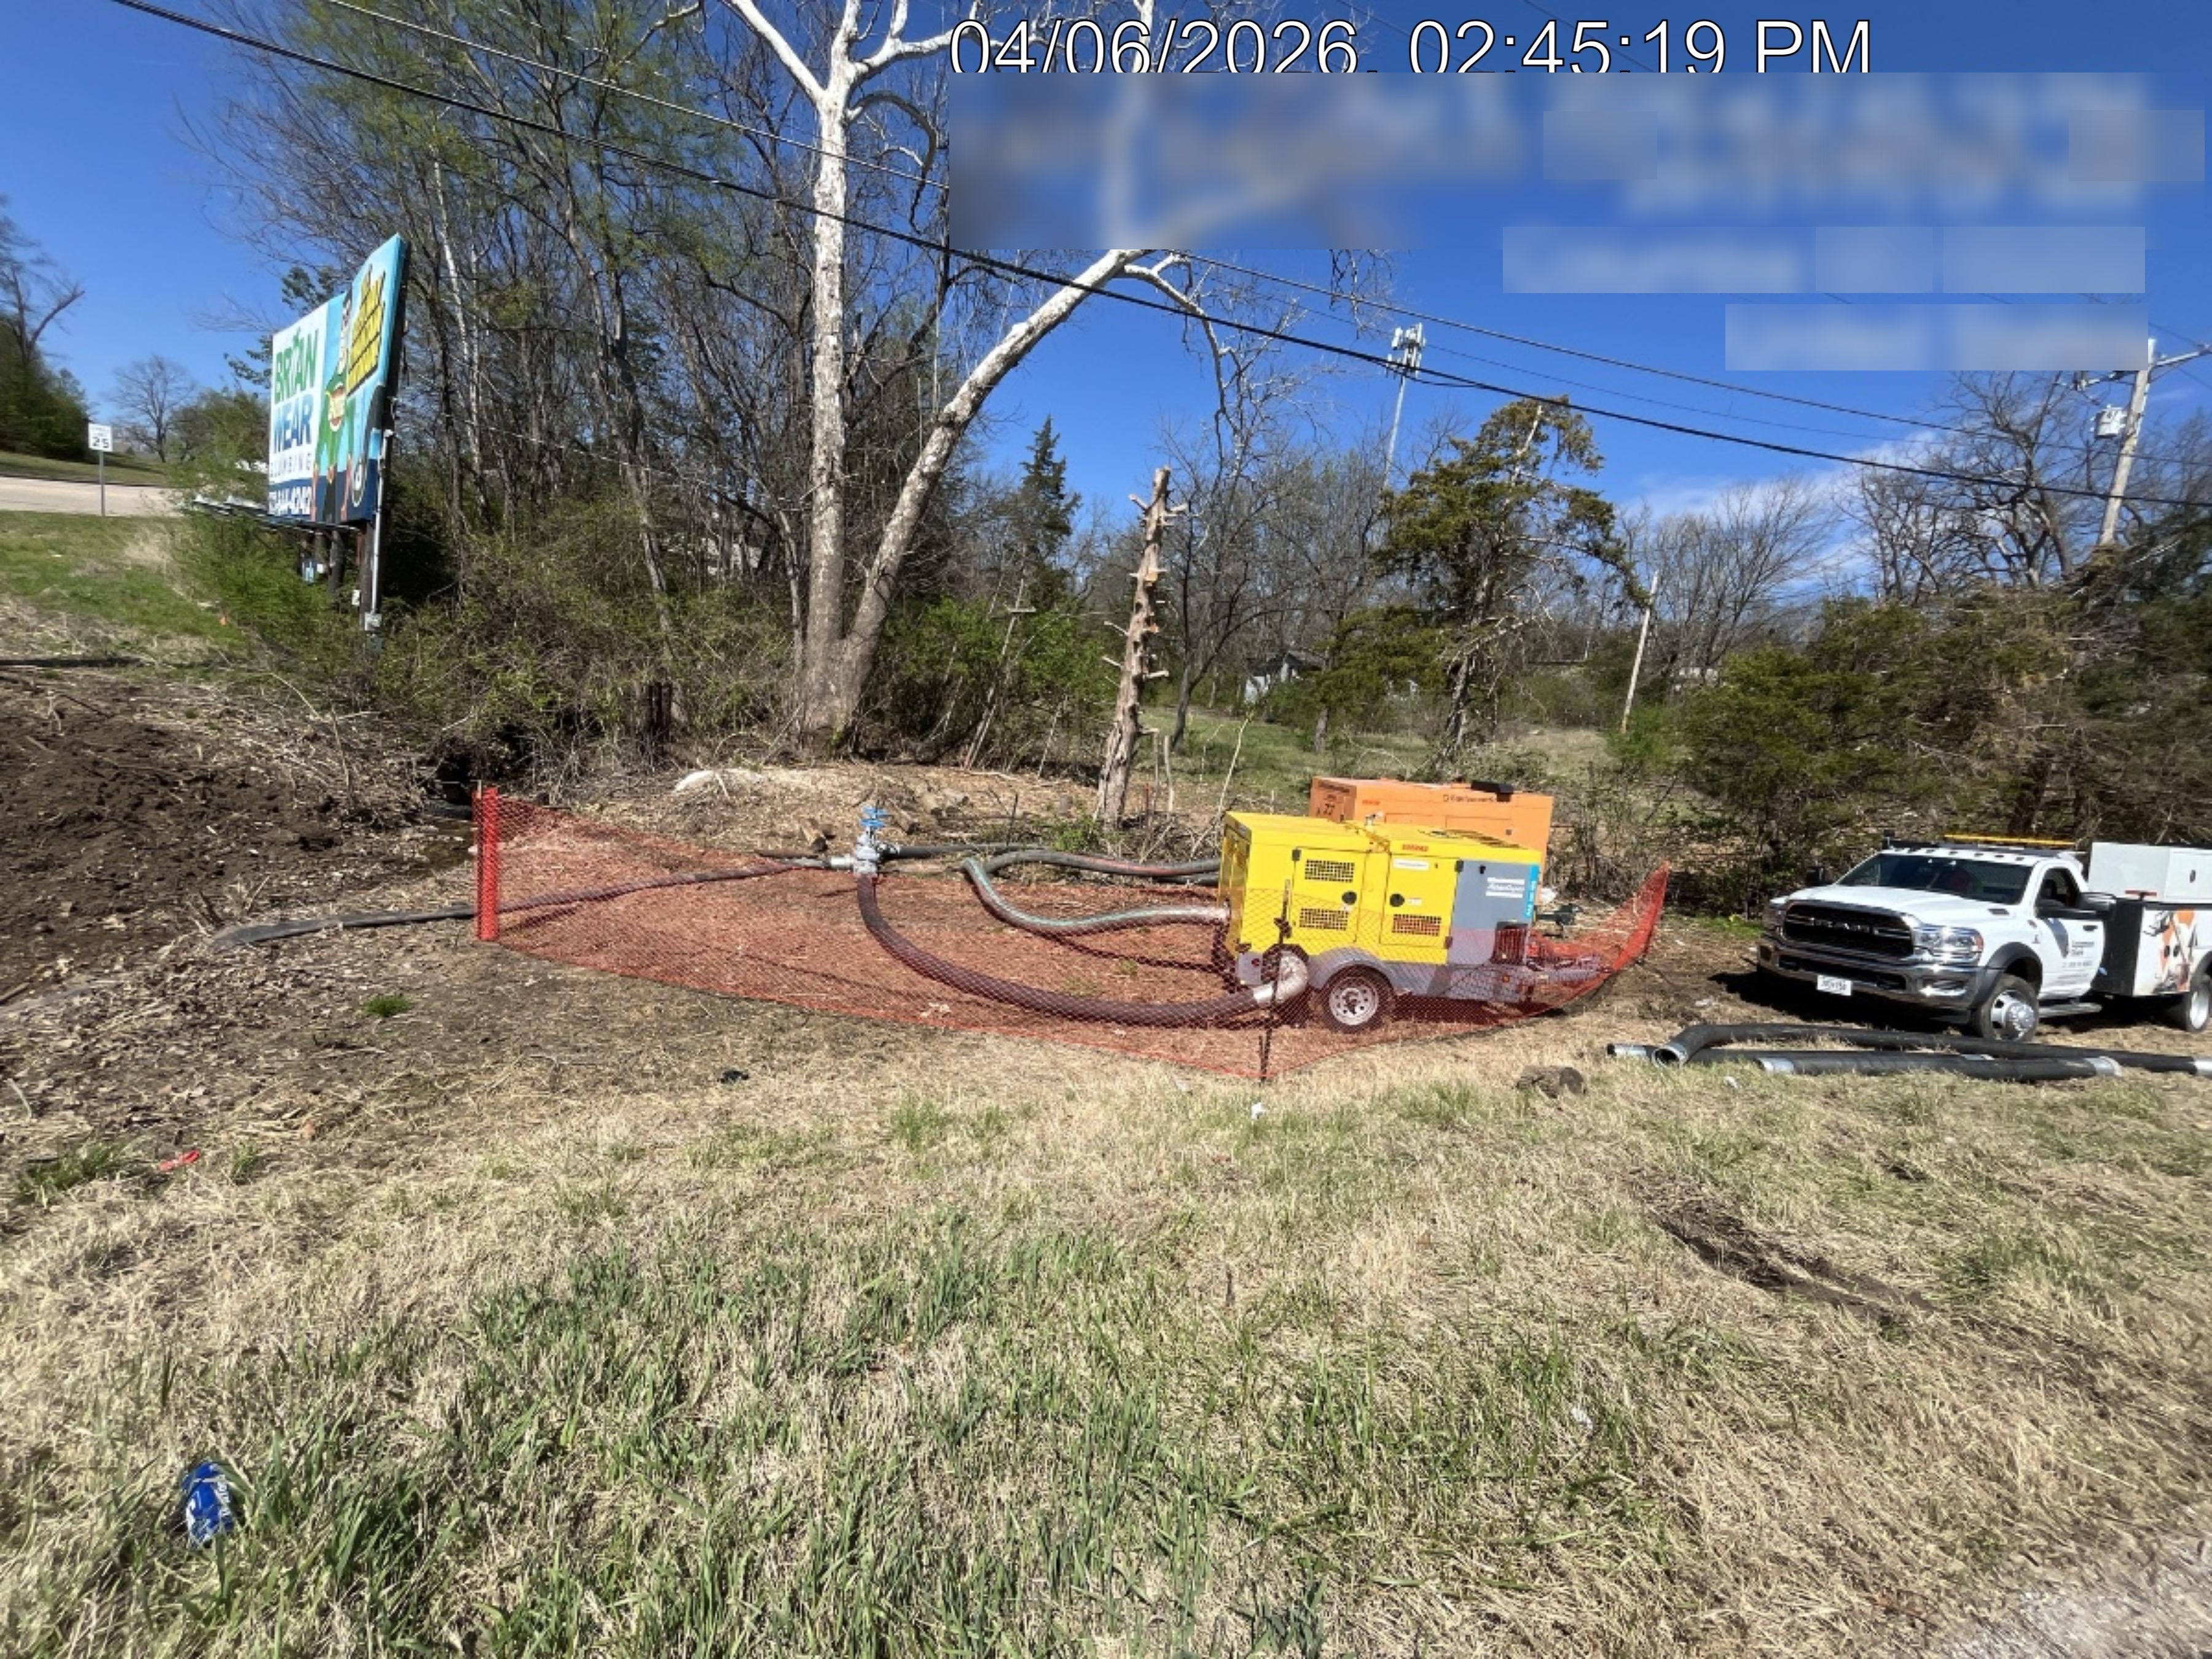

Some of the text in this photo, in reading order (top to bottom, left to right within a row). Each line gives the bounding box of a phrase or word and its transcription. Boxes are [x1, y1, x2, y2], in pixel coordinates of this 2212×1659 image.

[275, 328, 319, 404] BRIAN
[92, 437, 109, 448] 25
[274, 394, 314, 454] WEAR
